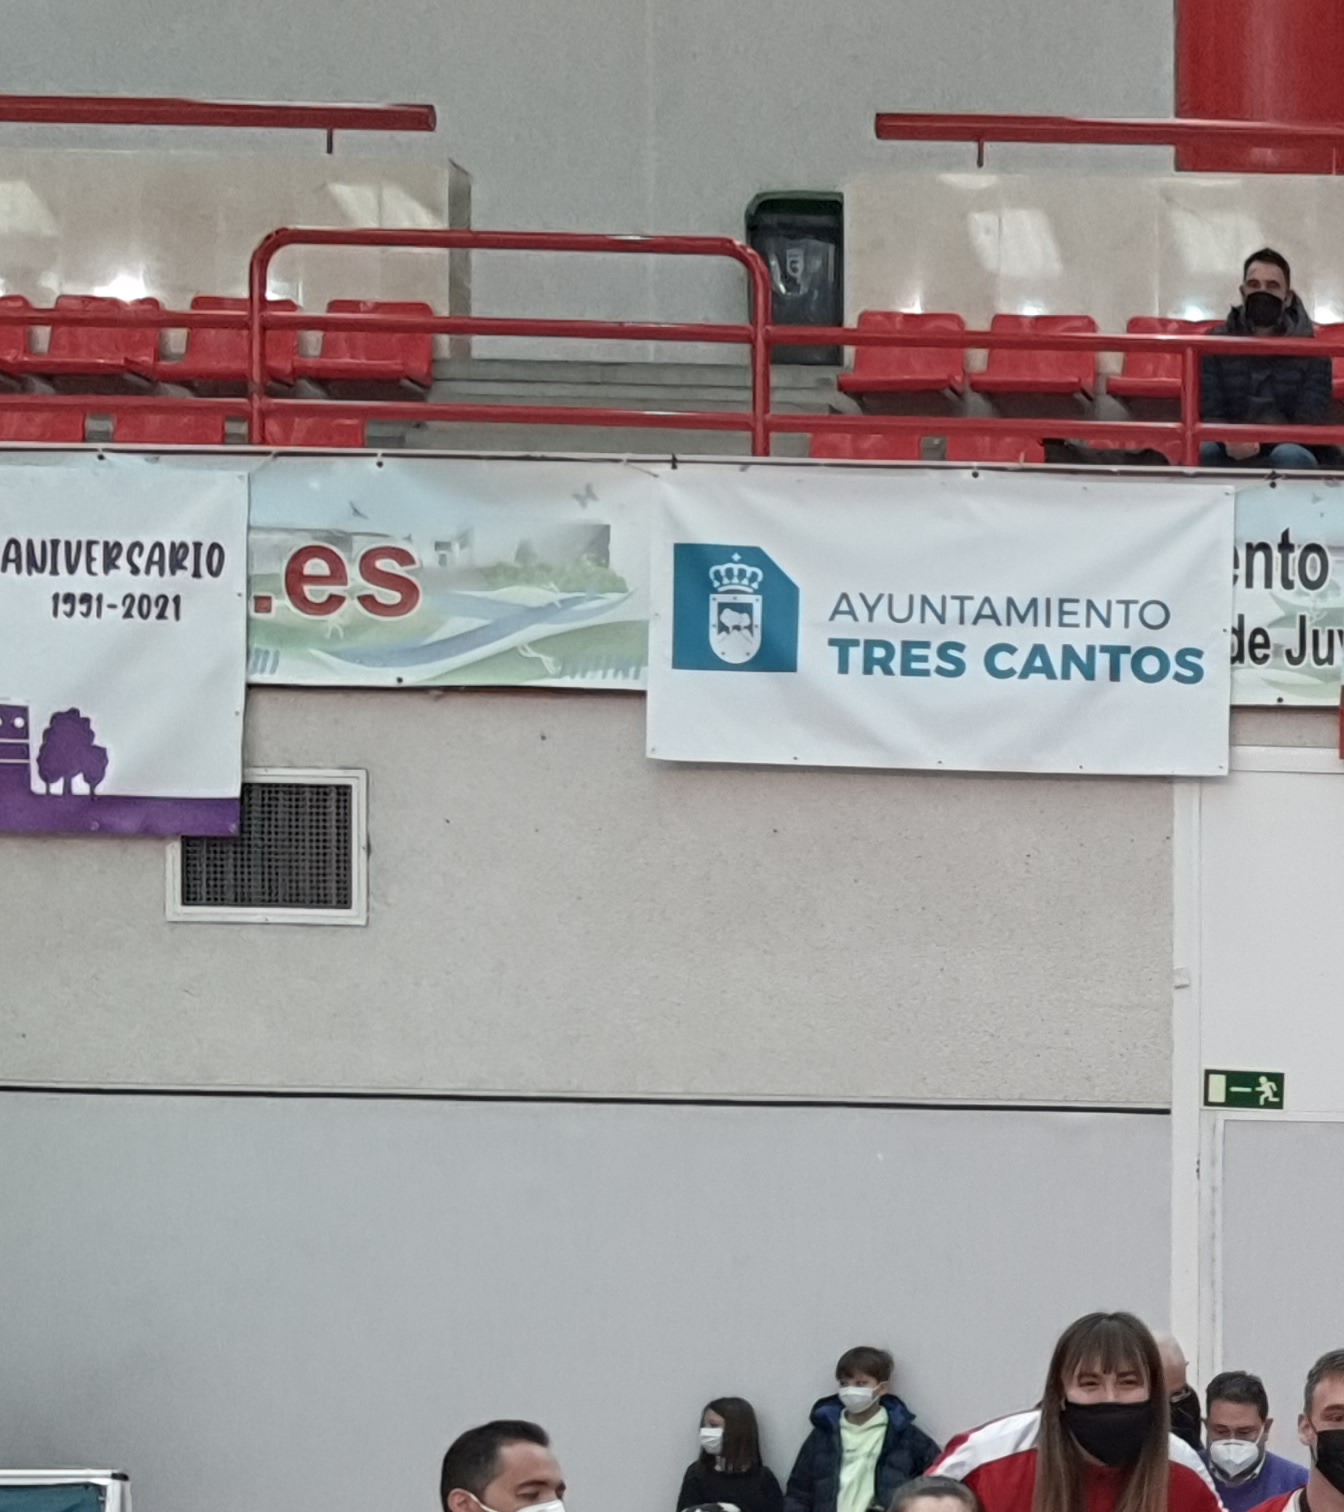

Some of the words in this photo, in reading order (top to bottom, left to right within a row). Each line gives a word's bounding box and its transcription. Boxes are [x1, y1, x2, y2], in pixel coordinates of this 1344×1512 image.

[1, 537, 226, 579] ANIVERSARIO
[52, 591, 181, 622] 1991-2021
[829, 592, 1170, 631] AYUNTAMIENTO
[828, 637, 966, 679] TRES
[984, 642, 1205, 685] CANTOS
